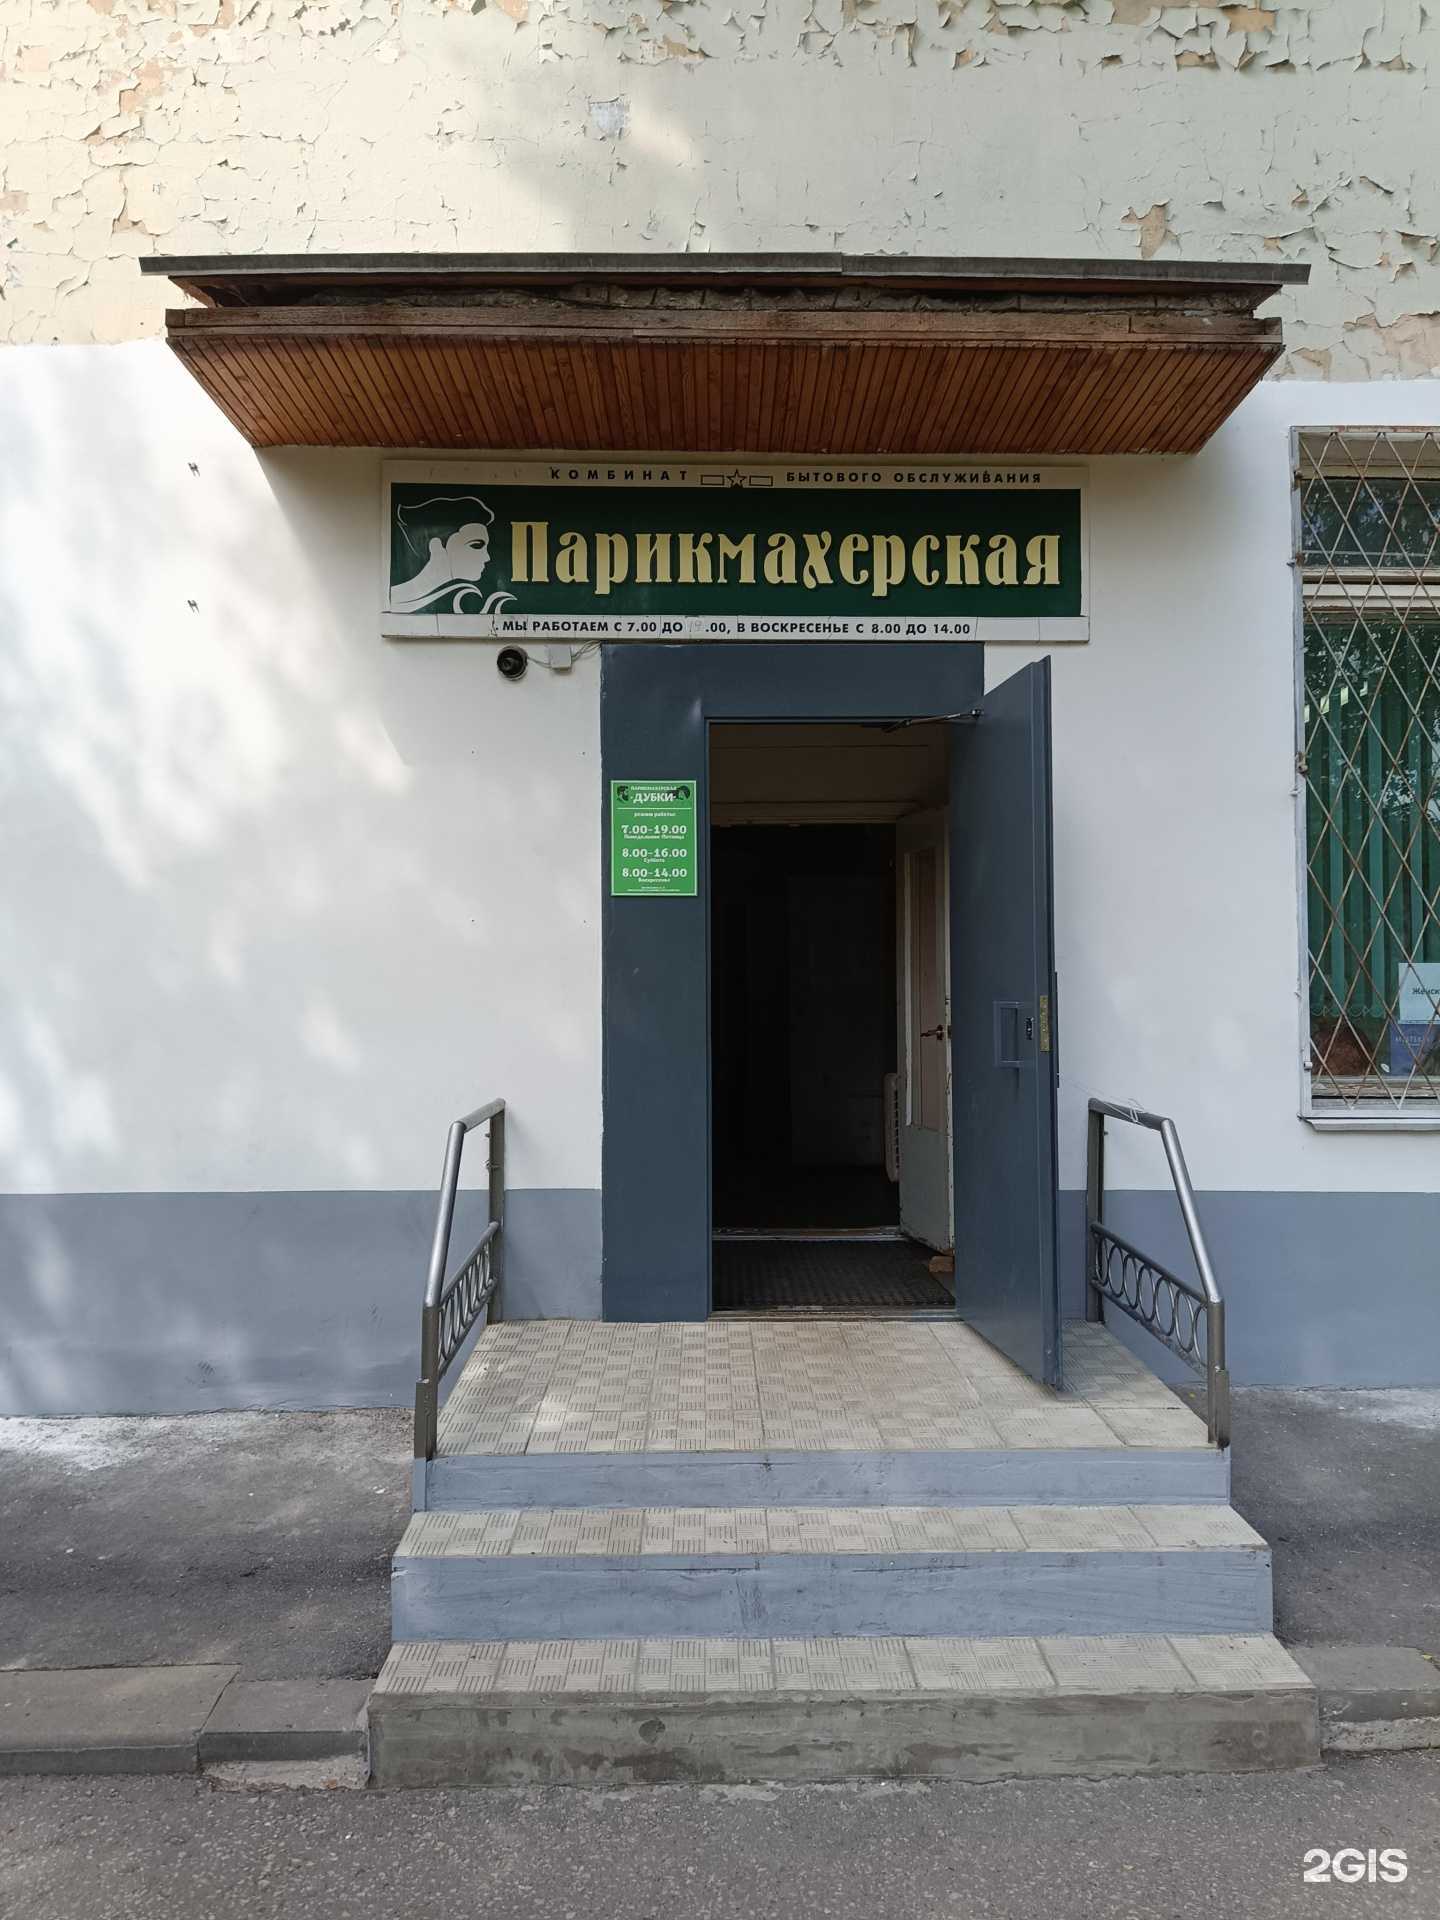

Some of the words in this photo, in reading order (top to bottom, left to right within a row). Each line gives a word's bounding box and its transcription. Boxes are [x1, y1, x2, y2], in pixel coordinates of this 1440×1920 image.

[551, 469, 687, 481] КОМБИНАТ
[786, 471, 882, 483] БЫТОВОГО
[894, 471, 1041, 484] ОБСЛУЖИВАНИЯ
[510, 520, 1061, 597] Парикмахерская
[532, 621, 609, 632] РАБОТАЕМ
[614, 621, 622, 632] С
[627, 621, 657, 633] 7.00
[661, 622, 683, 634] ДО
[736, 622, 746, 634] В
[750, 621, 849, 634] ВОСКРЕСЕНЬЕ
[855, 622, 864, 633] С
[871, 622, 901, 633] 8.00
[905, 623, 927, 635] ДО
[932, 623, 970, 634] 14.00
